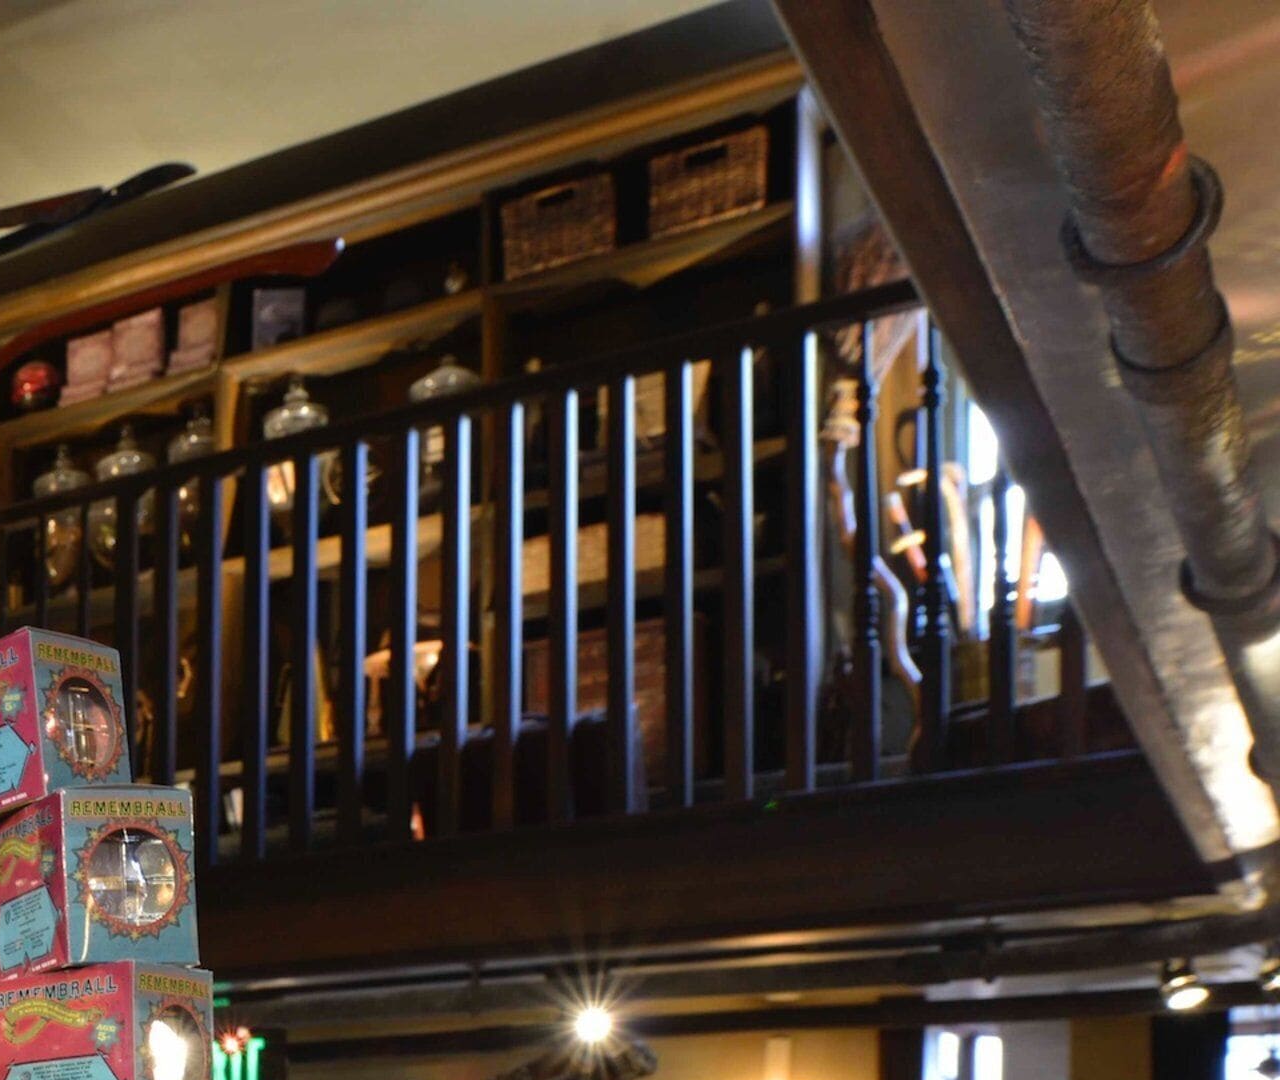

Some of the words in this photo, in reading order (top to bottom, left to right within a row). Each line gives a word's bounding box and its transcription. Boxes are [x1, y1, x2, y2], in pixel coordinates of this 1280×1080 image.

[37, 643, 118, 673] REMEMBRALL
[70, 800, 188, 817] REMEMBRALL
[140, 973, 209, 998] REMEMBRALL
